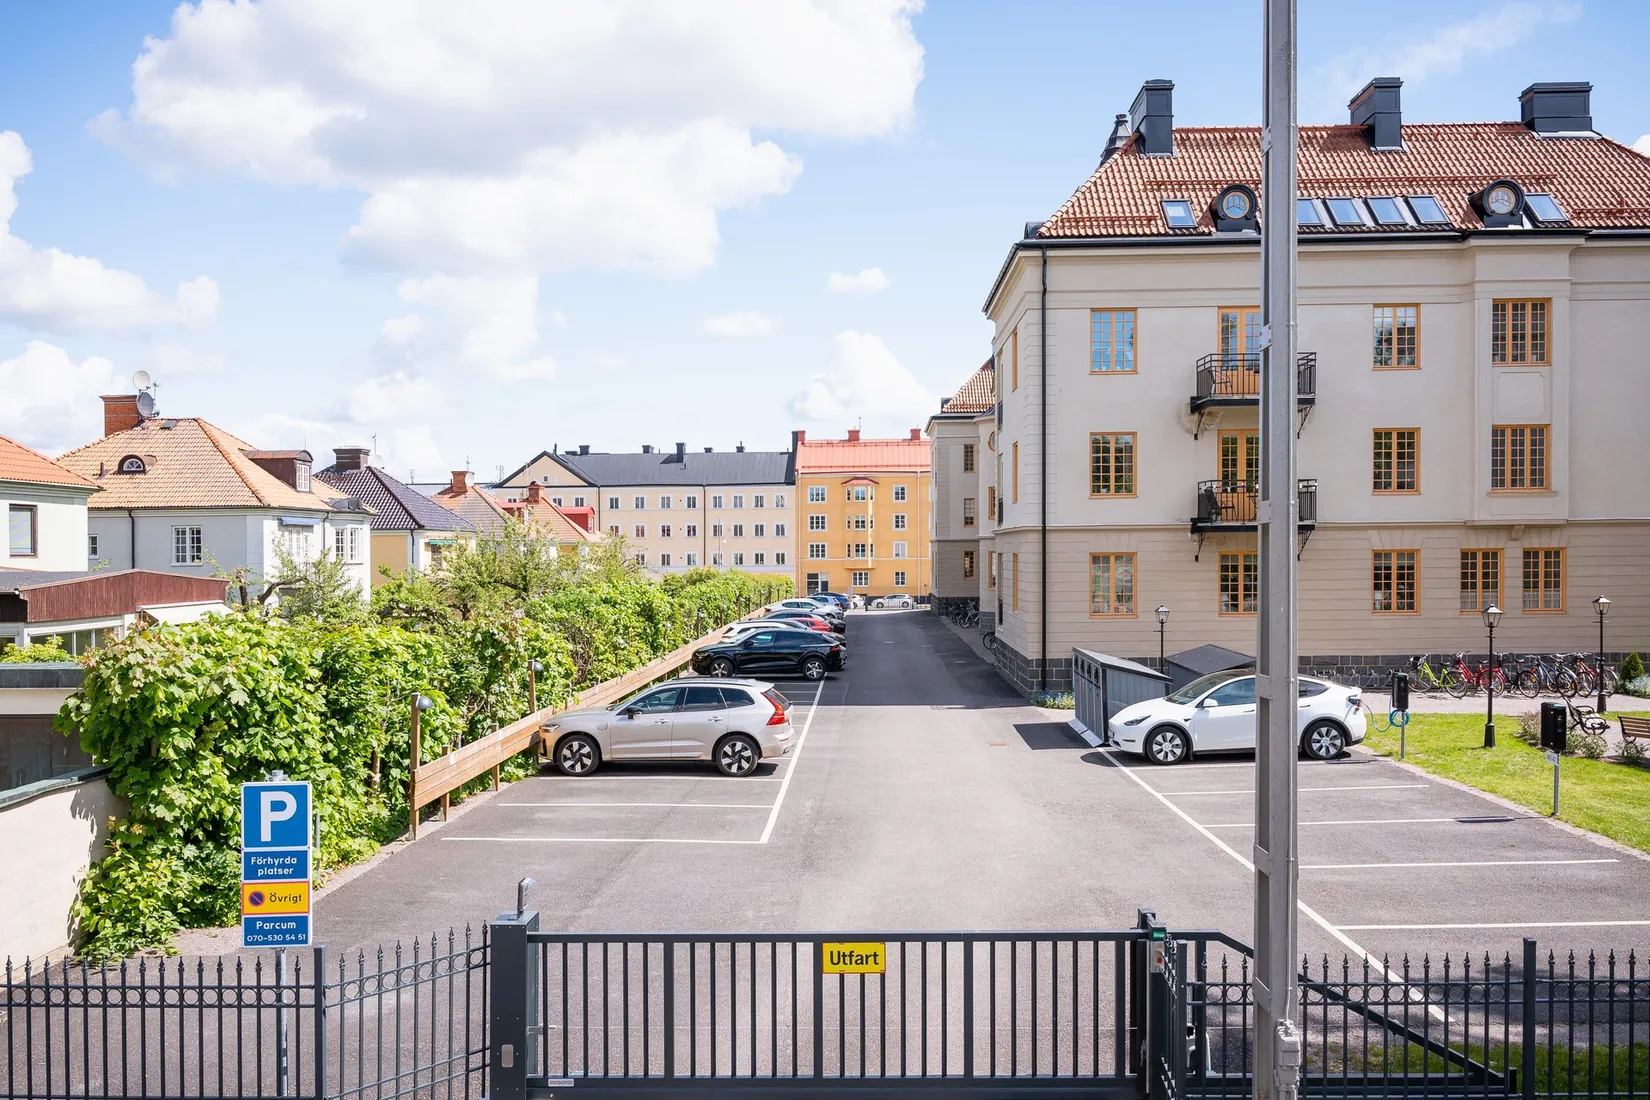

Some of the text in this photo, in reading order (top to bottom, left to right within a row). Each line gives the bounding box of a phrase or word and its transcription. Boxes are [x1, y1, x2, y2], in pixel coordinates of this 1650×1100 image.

[260, 791, 297, 842] P
[251, 856, 297, 866] Förhyrda
[258, 867, 294, 877] platser
[269, 892, 302, 904] Övrigt
[256, 921, 296, 930] Parcum
[247, 934, 283, 942] 070-530
[285, 933, 296, 941] 54
[829, 950, 879, 965] Utfart
